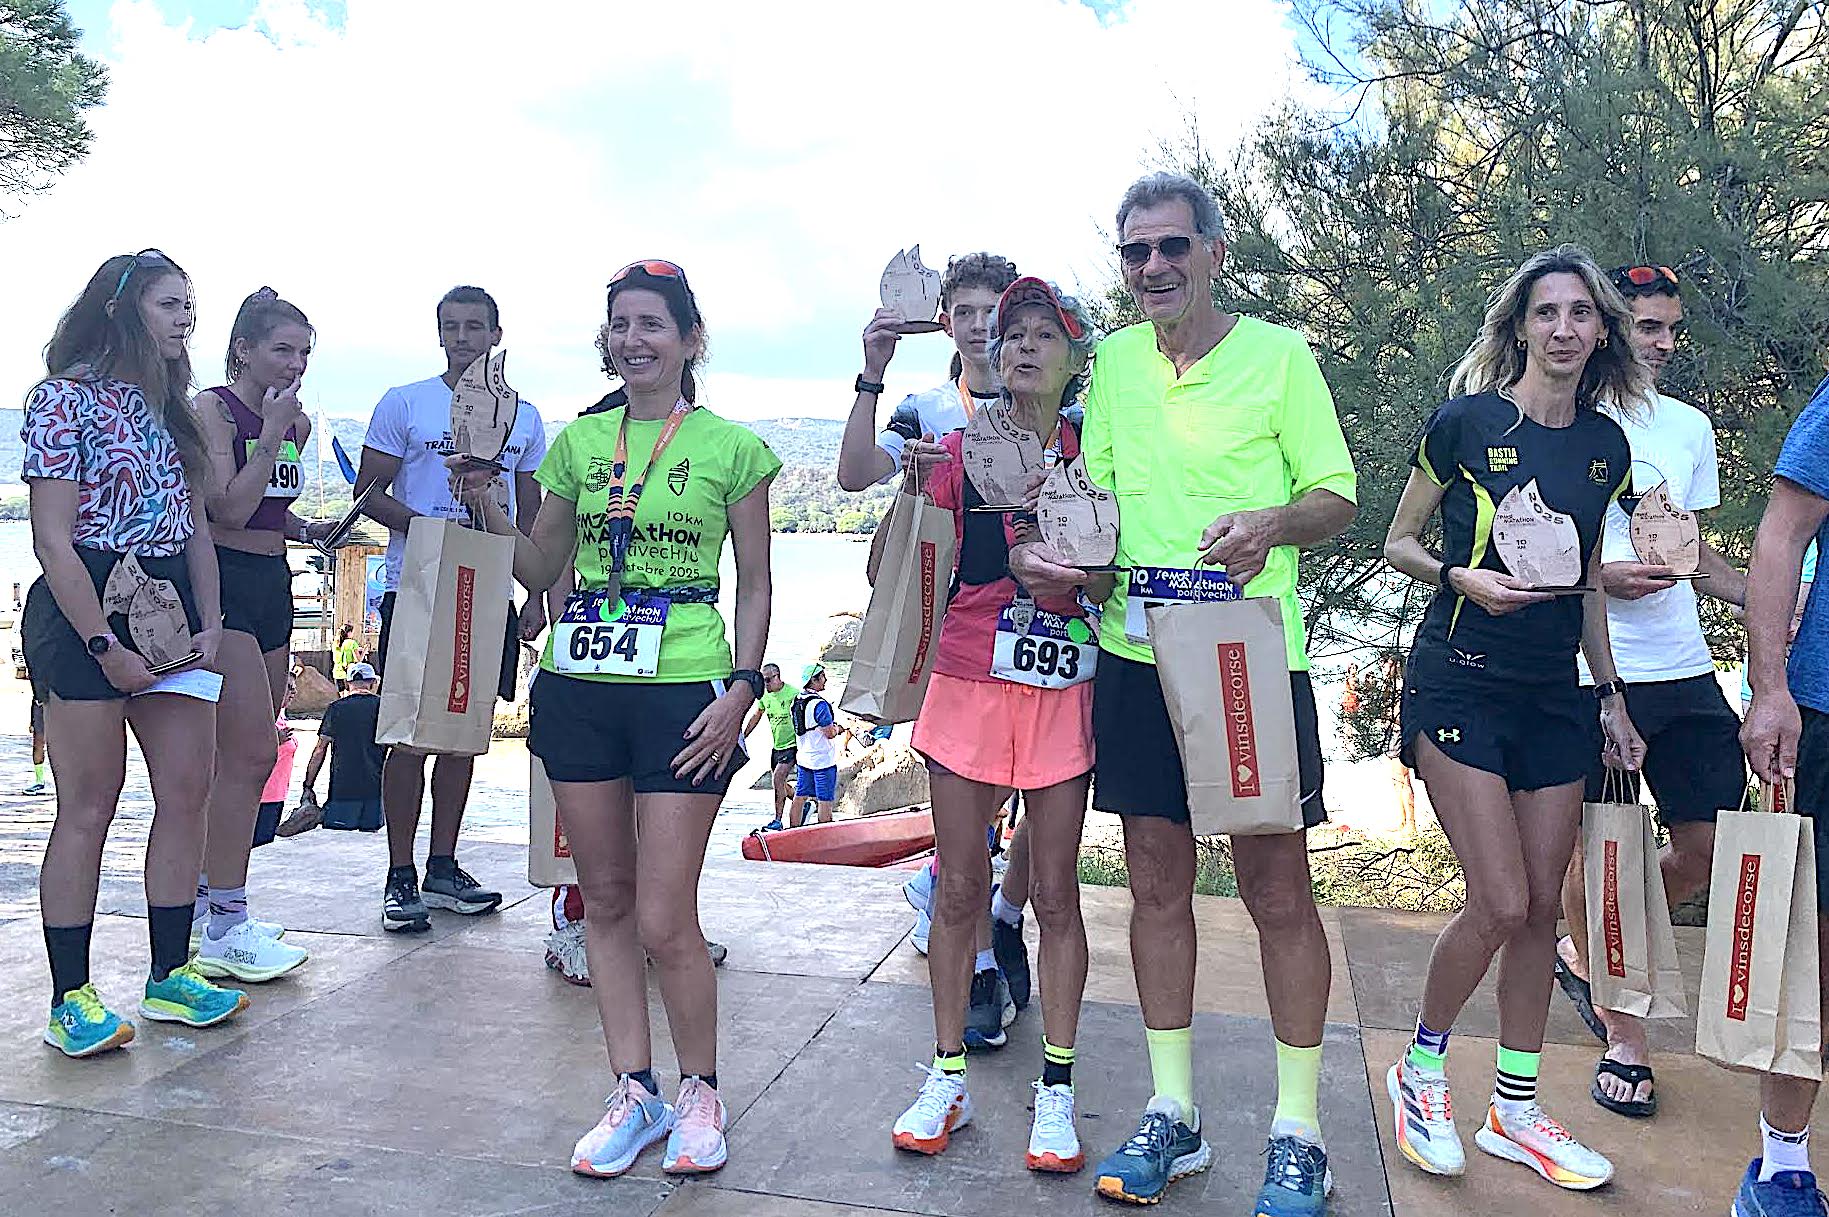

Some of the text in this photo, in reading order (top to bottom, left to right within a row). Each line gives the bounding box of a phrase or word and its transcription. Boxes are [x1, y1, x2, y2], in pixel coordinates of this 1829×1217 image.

[492, 362, 511, 400] 2025
[997, 409, 1030, 441] 2025
[425, 441, 455, 450] TRAIL
[1488, 448, 1517, 457] BASTIA
[1074, 469, 1108, 501] 2025
[1528, 492, 1564, 525] 2025
[1659, 493, 1689, 521] 2025
[601, 564, 612, 575] 19
[669, 565, 700, 579] 2025
[1131, 569, 1149, 585] 10
[451, 573, 472, 709] I vinsdecorse
[569, 625, 639, 662] 654
[1013, 637, 1080, 680] 693
[1228, 648, 1255, 793] I vinsdecorse
[1606, 846, 1623, 971] I vinsdecorse
[1732, 861, 1757, 1015] I vinsdecorse
[1769, 1131, 1808, 1145] CEP
